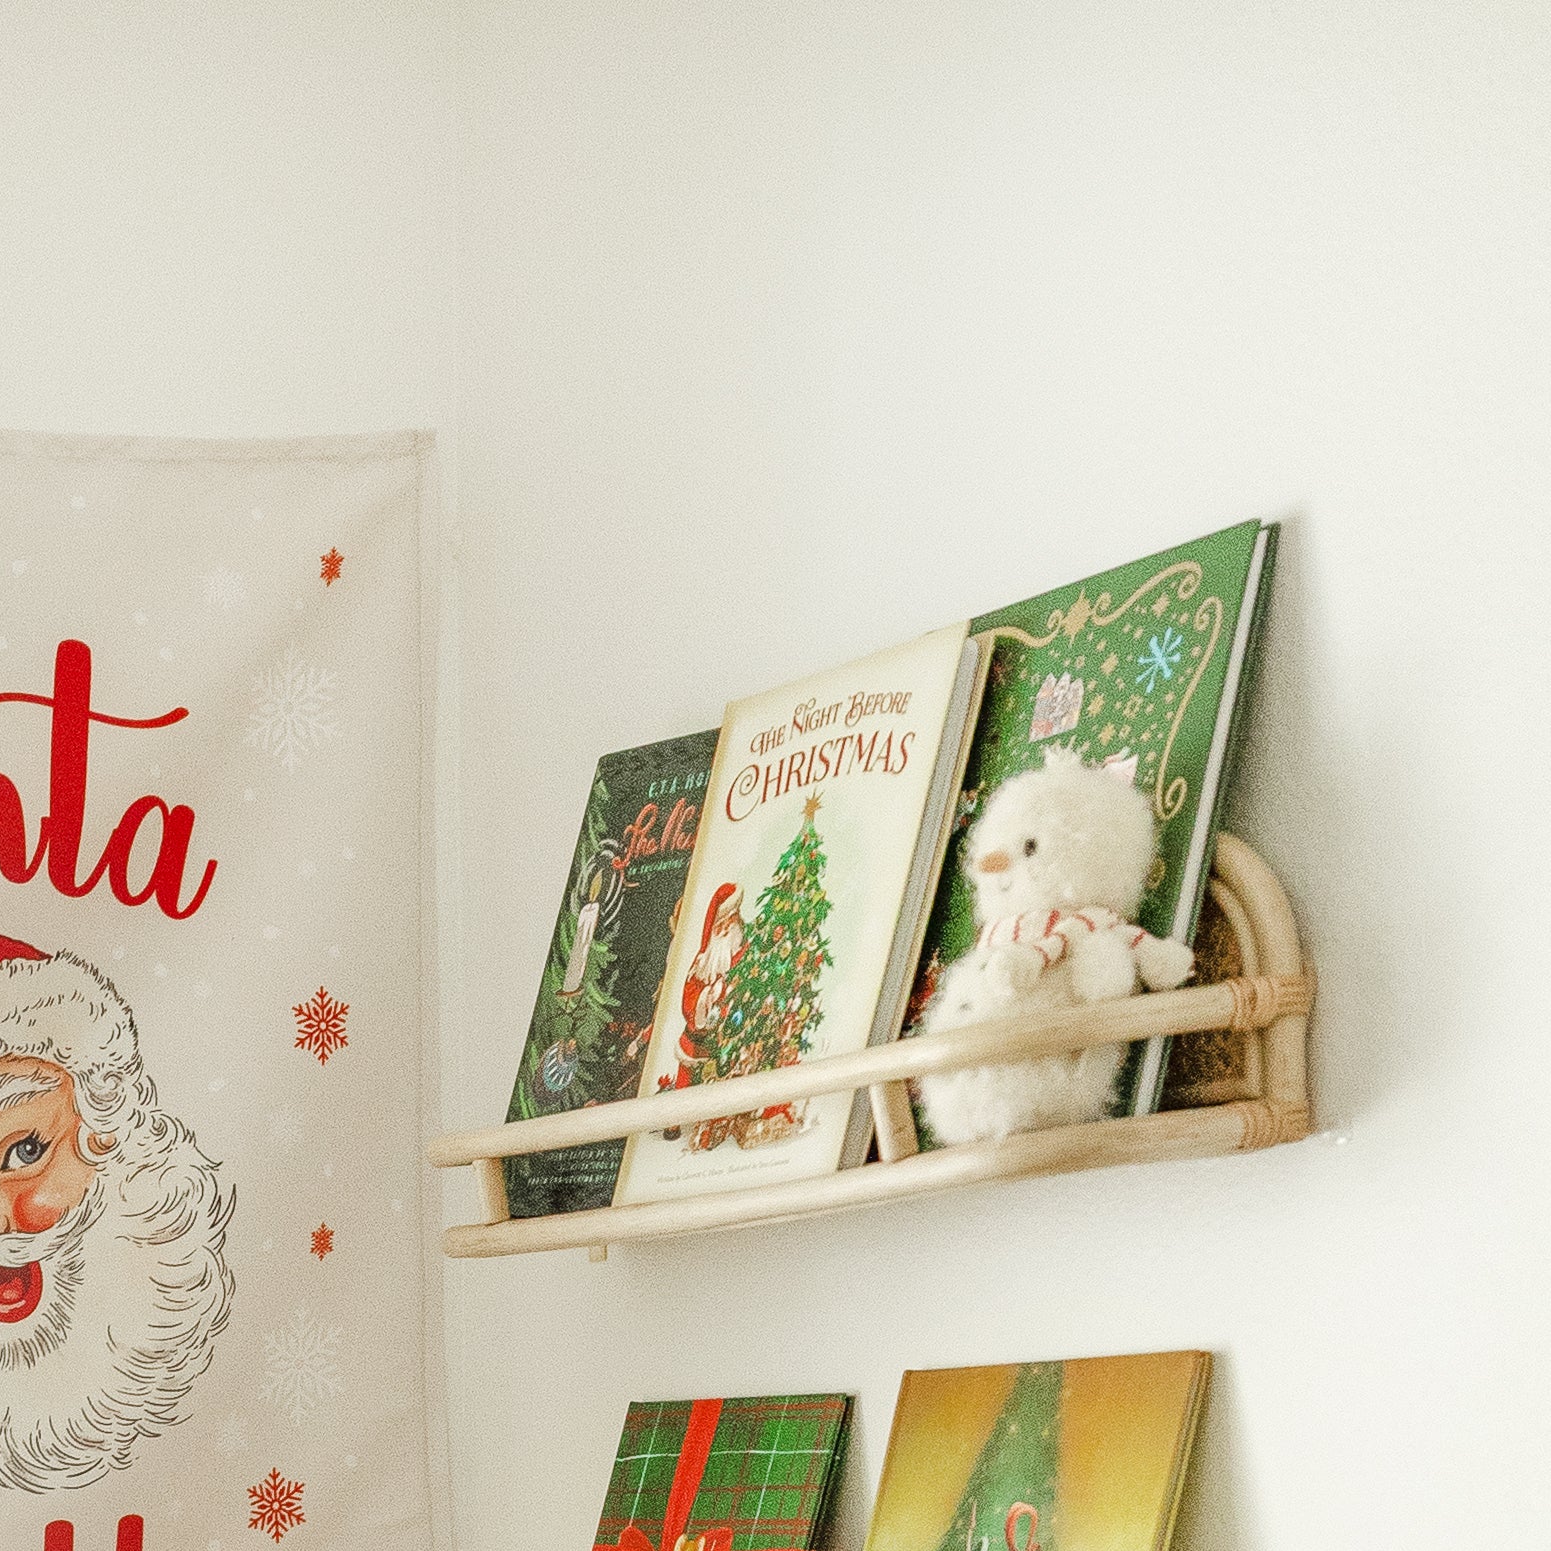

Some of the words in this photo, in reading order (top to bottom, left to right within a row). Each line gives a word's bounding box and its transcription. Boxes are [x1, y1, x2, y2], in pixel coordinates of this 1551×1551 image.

[750, 724, 787, 756] THE
[789, 697, 843, 740] NIGHT
[844, 691, 912, 727] BEFORE
[725, 730, 916, 822] CHRISTMAS
